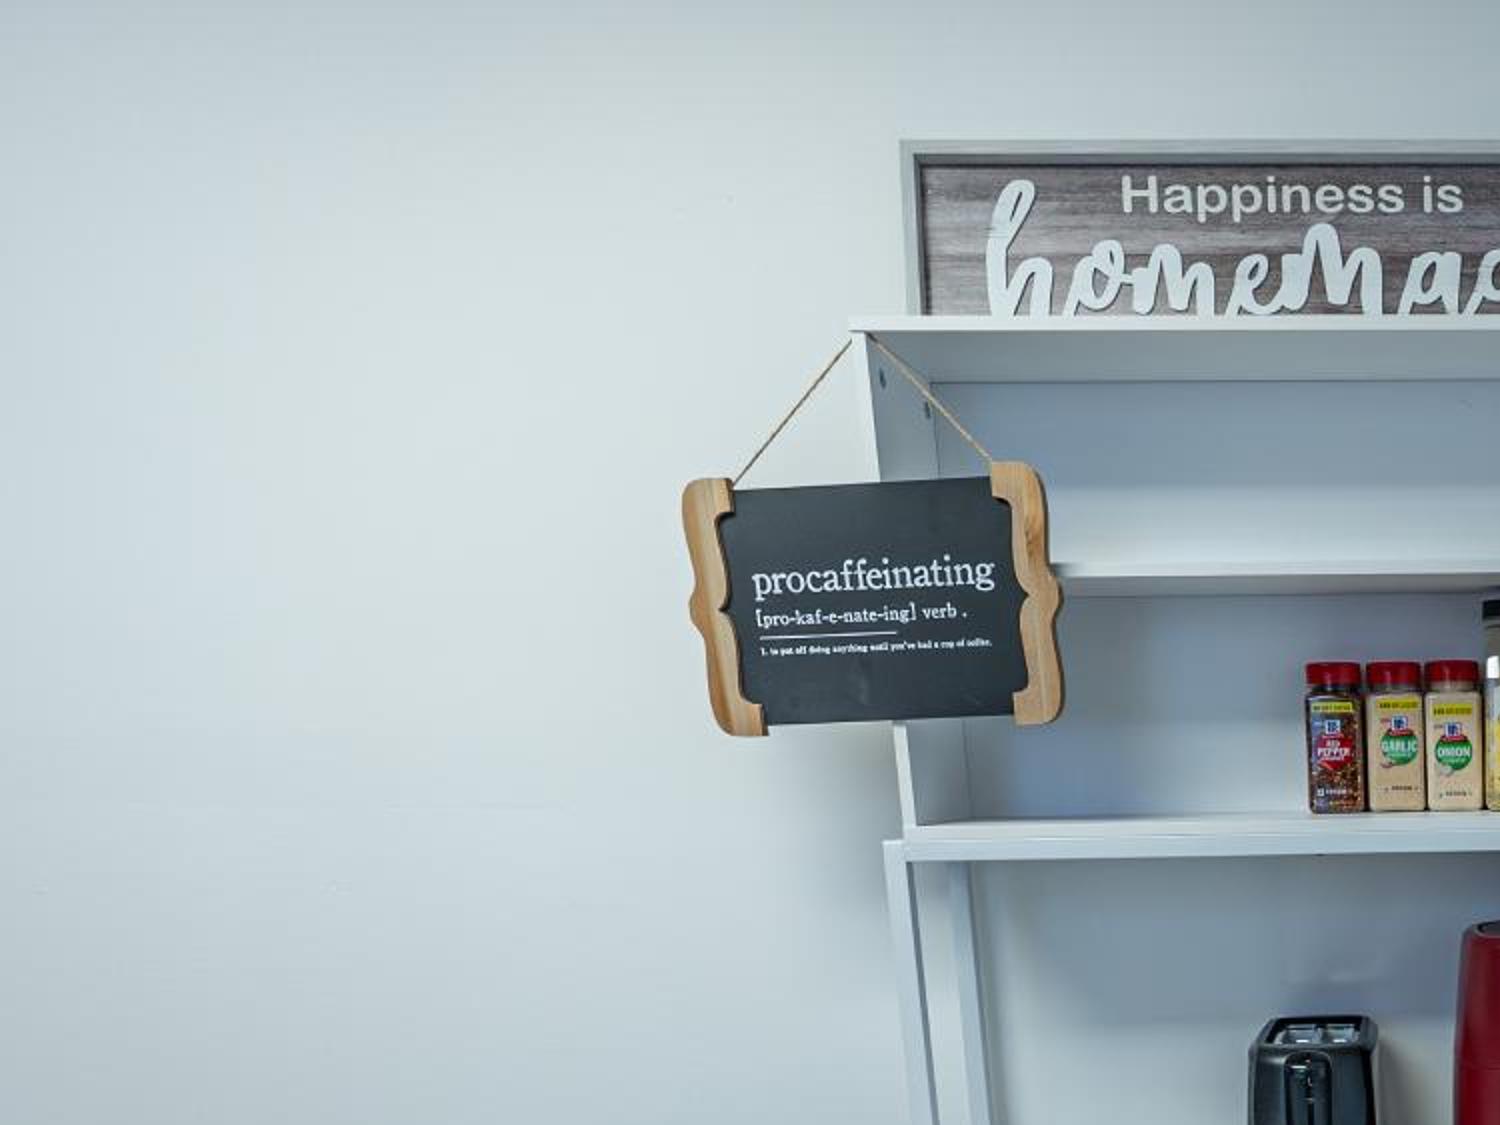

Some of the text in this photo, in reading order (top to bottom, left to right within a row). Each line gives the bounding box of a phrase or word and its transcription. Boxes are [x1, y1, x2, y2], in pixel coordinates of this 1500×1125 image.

[1121, 175, 1464, 224] Happiness is
[752, 553, 996, 602] procaffeinating
[1381, 739, 1418, 753] GARLIC
[1437, 745, 1471, 758] ONION
